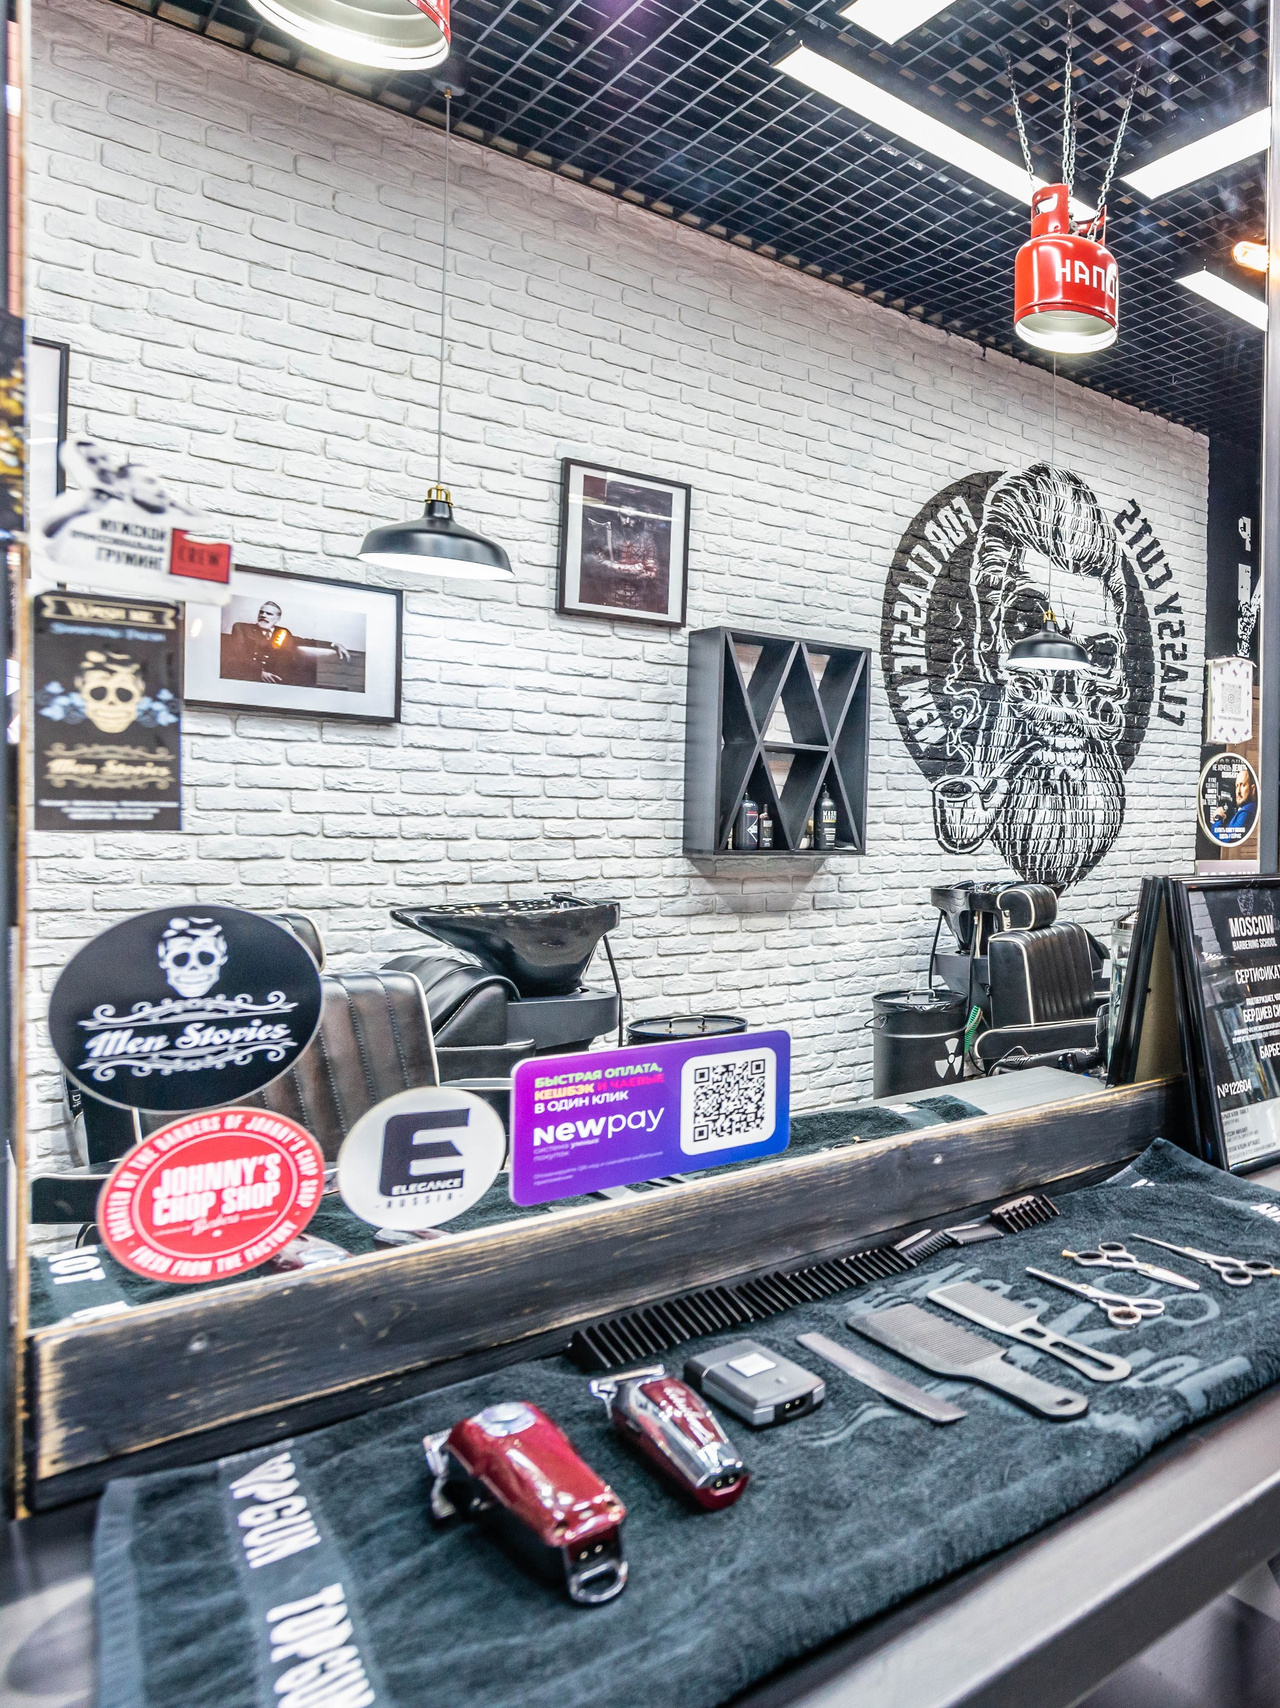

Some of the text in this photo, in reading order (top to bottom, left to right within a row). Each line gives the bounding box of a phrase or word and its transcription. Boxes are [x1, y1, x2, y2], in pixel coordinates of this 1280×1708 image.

[1228, 914, 1275, 939] MOSCOW
[1232, 937, 1278, 951] BARBERING SCHOOL
[1242, 1005, 1273, 1023] БЕРДИЕВ
[85, 1018, 292, 1059] Men Stories
[534, 1062, 663, 1088] БЫСТРАЯ ОПЛАТА,
[534, 1083, 595, 1101] КЕШБЭК
[534, 1090, 629, 1114] В ОДИН КЛИК
[152, 1153, 282, 1200] JOHNNY'S
[391, 1178, 462, 1196] ELEGANCE
[152, 1180, 281, 1226] CHOP SHOP
